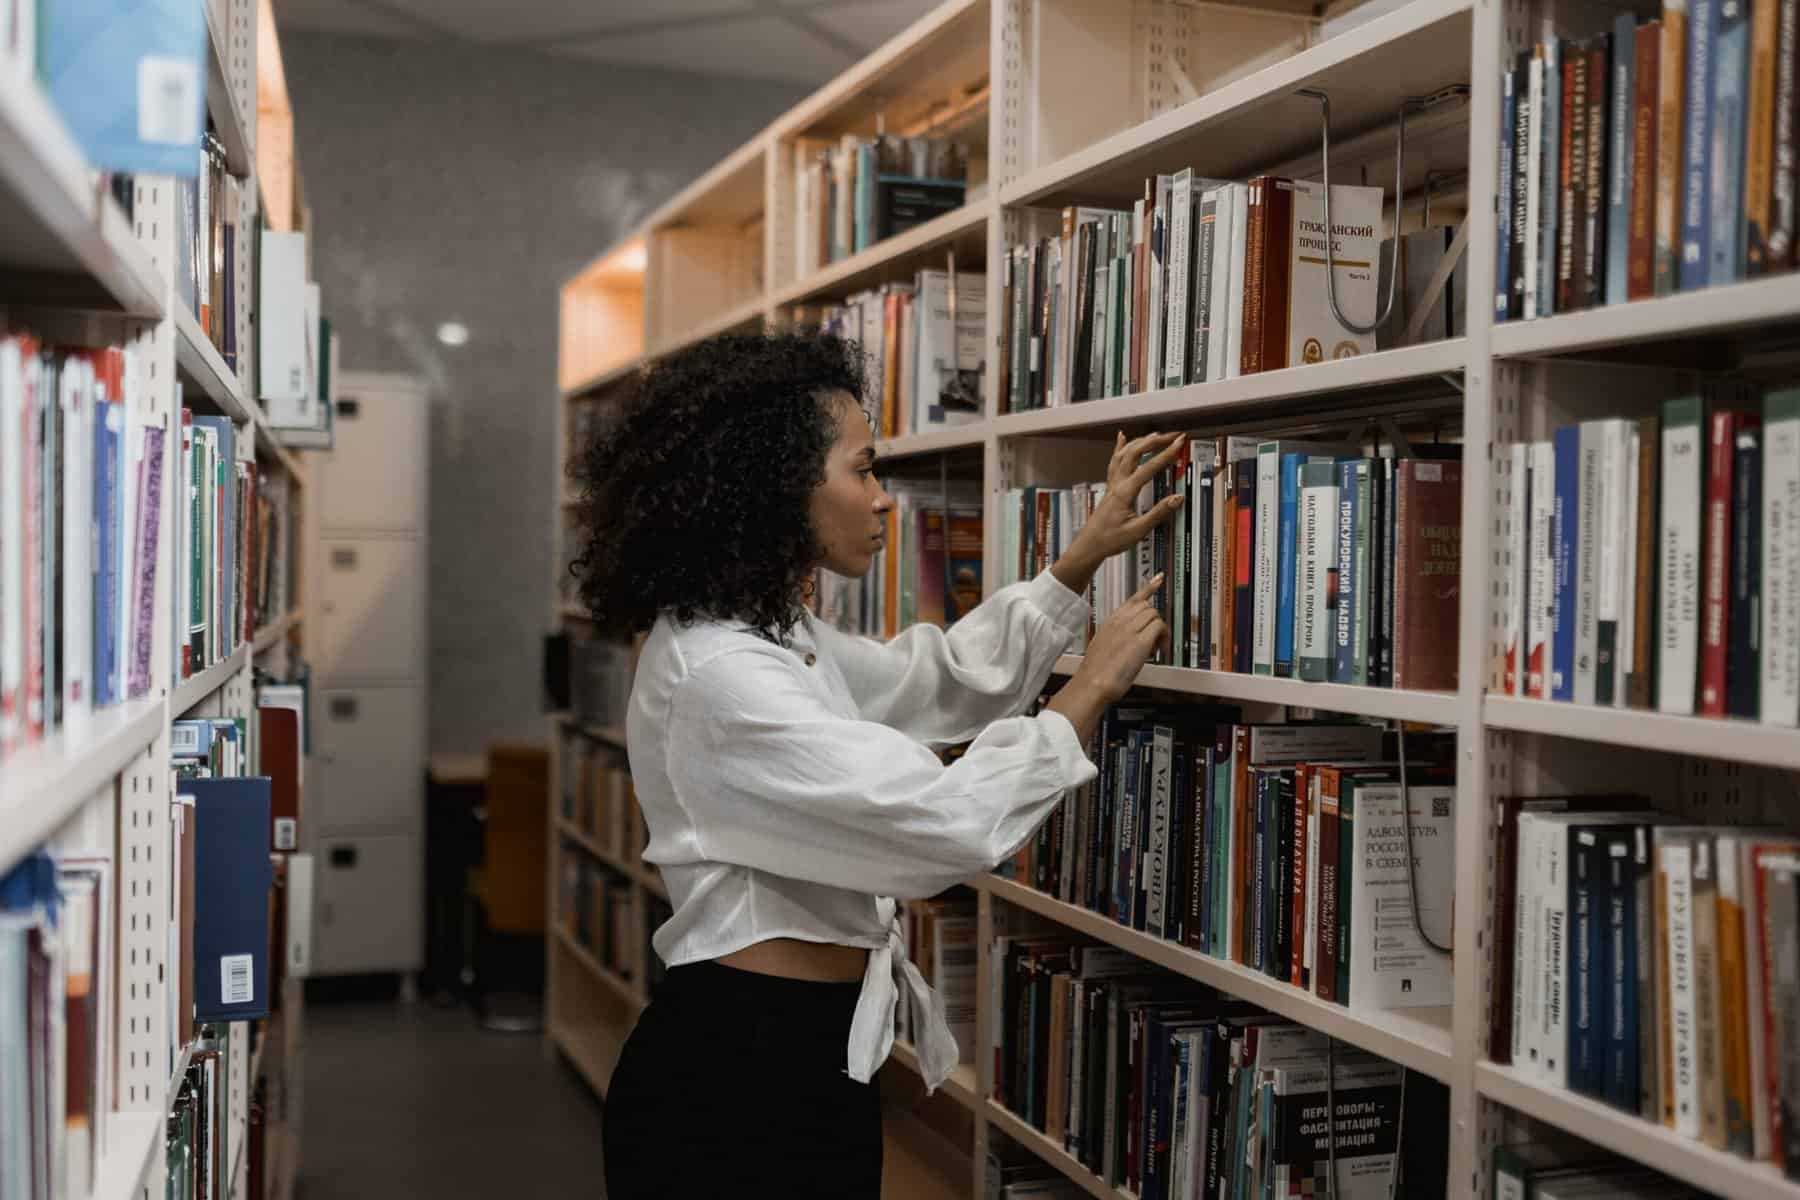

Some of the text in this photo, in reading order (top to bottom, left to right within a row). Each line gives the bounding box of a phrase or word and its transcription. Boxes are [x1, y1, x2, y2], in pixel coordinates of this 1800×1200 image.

[1299, 220, 1373, 238] ГРАЖАНСКИЙ
[1299, 238, 1341, 252] ПРОЦСС
[1304, 495, 1316, 649] НАСТОЛЬНАЯ КНИГА ПРОКУРОРА
[1338, 501, 1352, 647] ПРОКУРОРСКИЙ НАДЗОР
[1152, 767, 1167, 921] АДВОКАТУРА
[1293, 797, 1303, 894] АДВОКАТУРА
[1366, 826, 1438, 839] АДВОКТУРА
[1551, 911, 1564, 1025] Трудовые споры
[1672, 879, 1690, 1086] ТРУДОВОЕ ПРАВО
[1300, 1117, 1381, 1135] ФАСИИТАЦИЯ
[1303, 1102, 1375, 1119] ПЕРЕОВОРЫ
[1315, 1133, 1375, 1149] МЕИАЦИЯ
